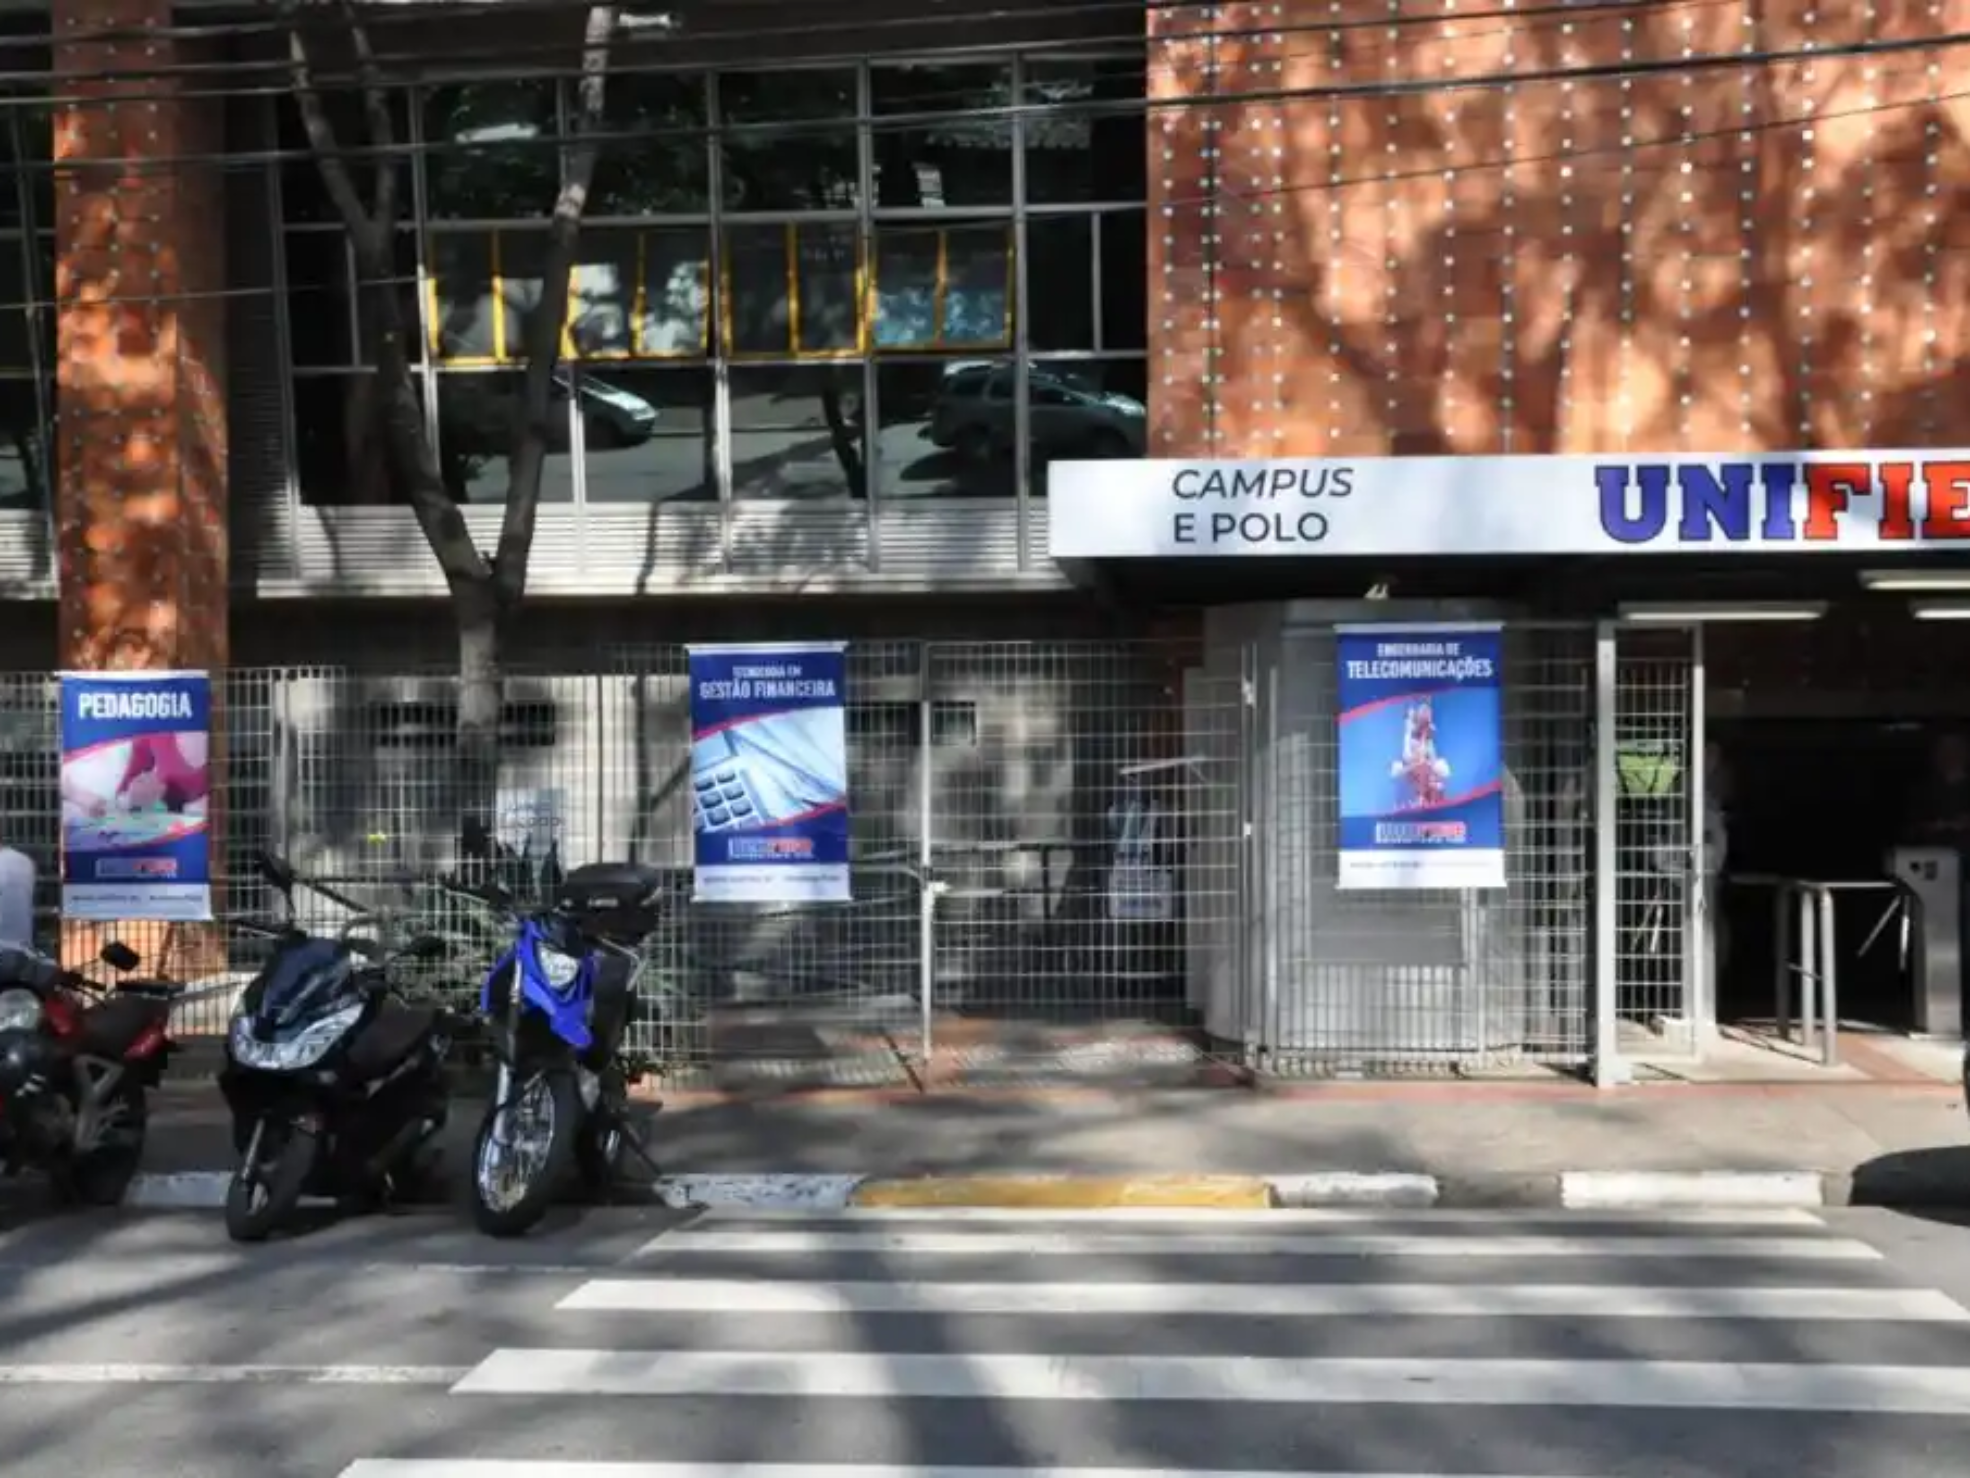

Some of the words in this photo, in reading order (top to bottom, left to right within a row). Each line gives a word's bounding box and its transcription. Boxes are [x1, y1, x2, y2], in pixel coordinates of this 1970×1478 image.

[1172, 468, 1354, 500] CAMPUS
[1174, 513, 1196, 542] E
[1212, 512, 1328, 542] POLO
[1347, 656, 1493, 682] TELECOMUNICAÇÕES
[700, 677, 751, 699] GESTÃO
[754, 680, 836, 698] FINANCEIRA
[79, 693, 192, 718] PEDAGOGIA
